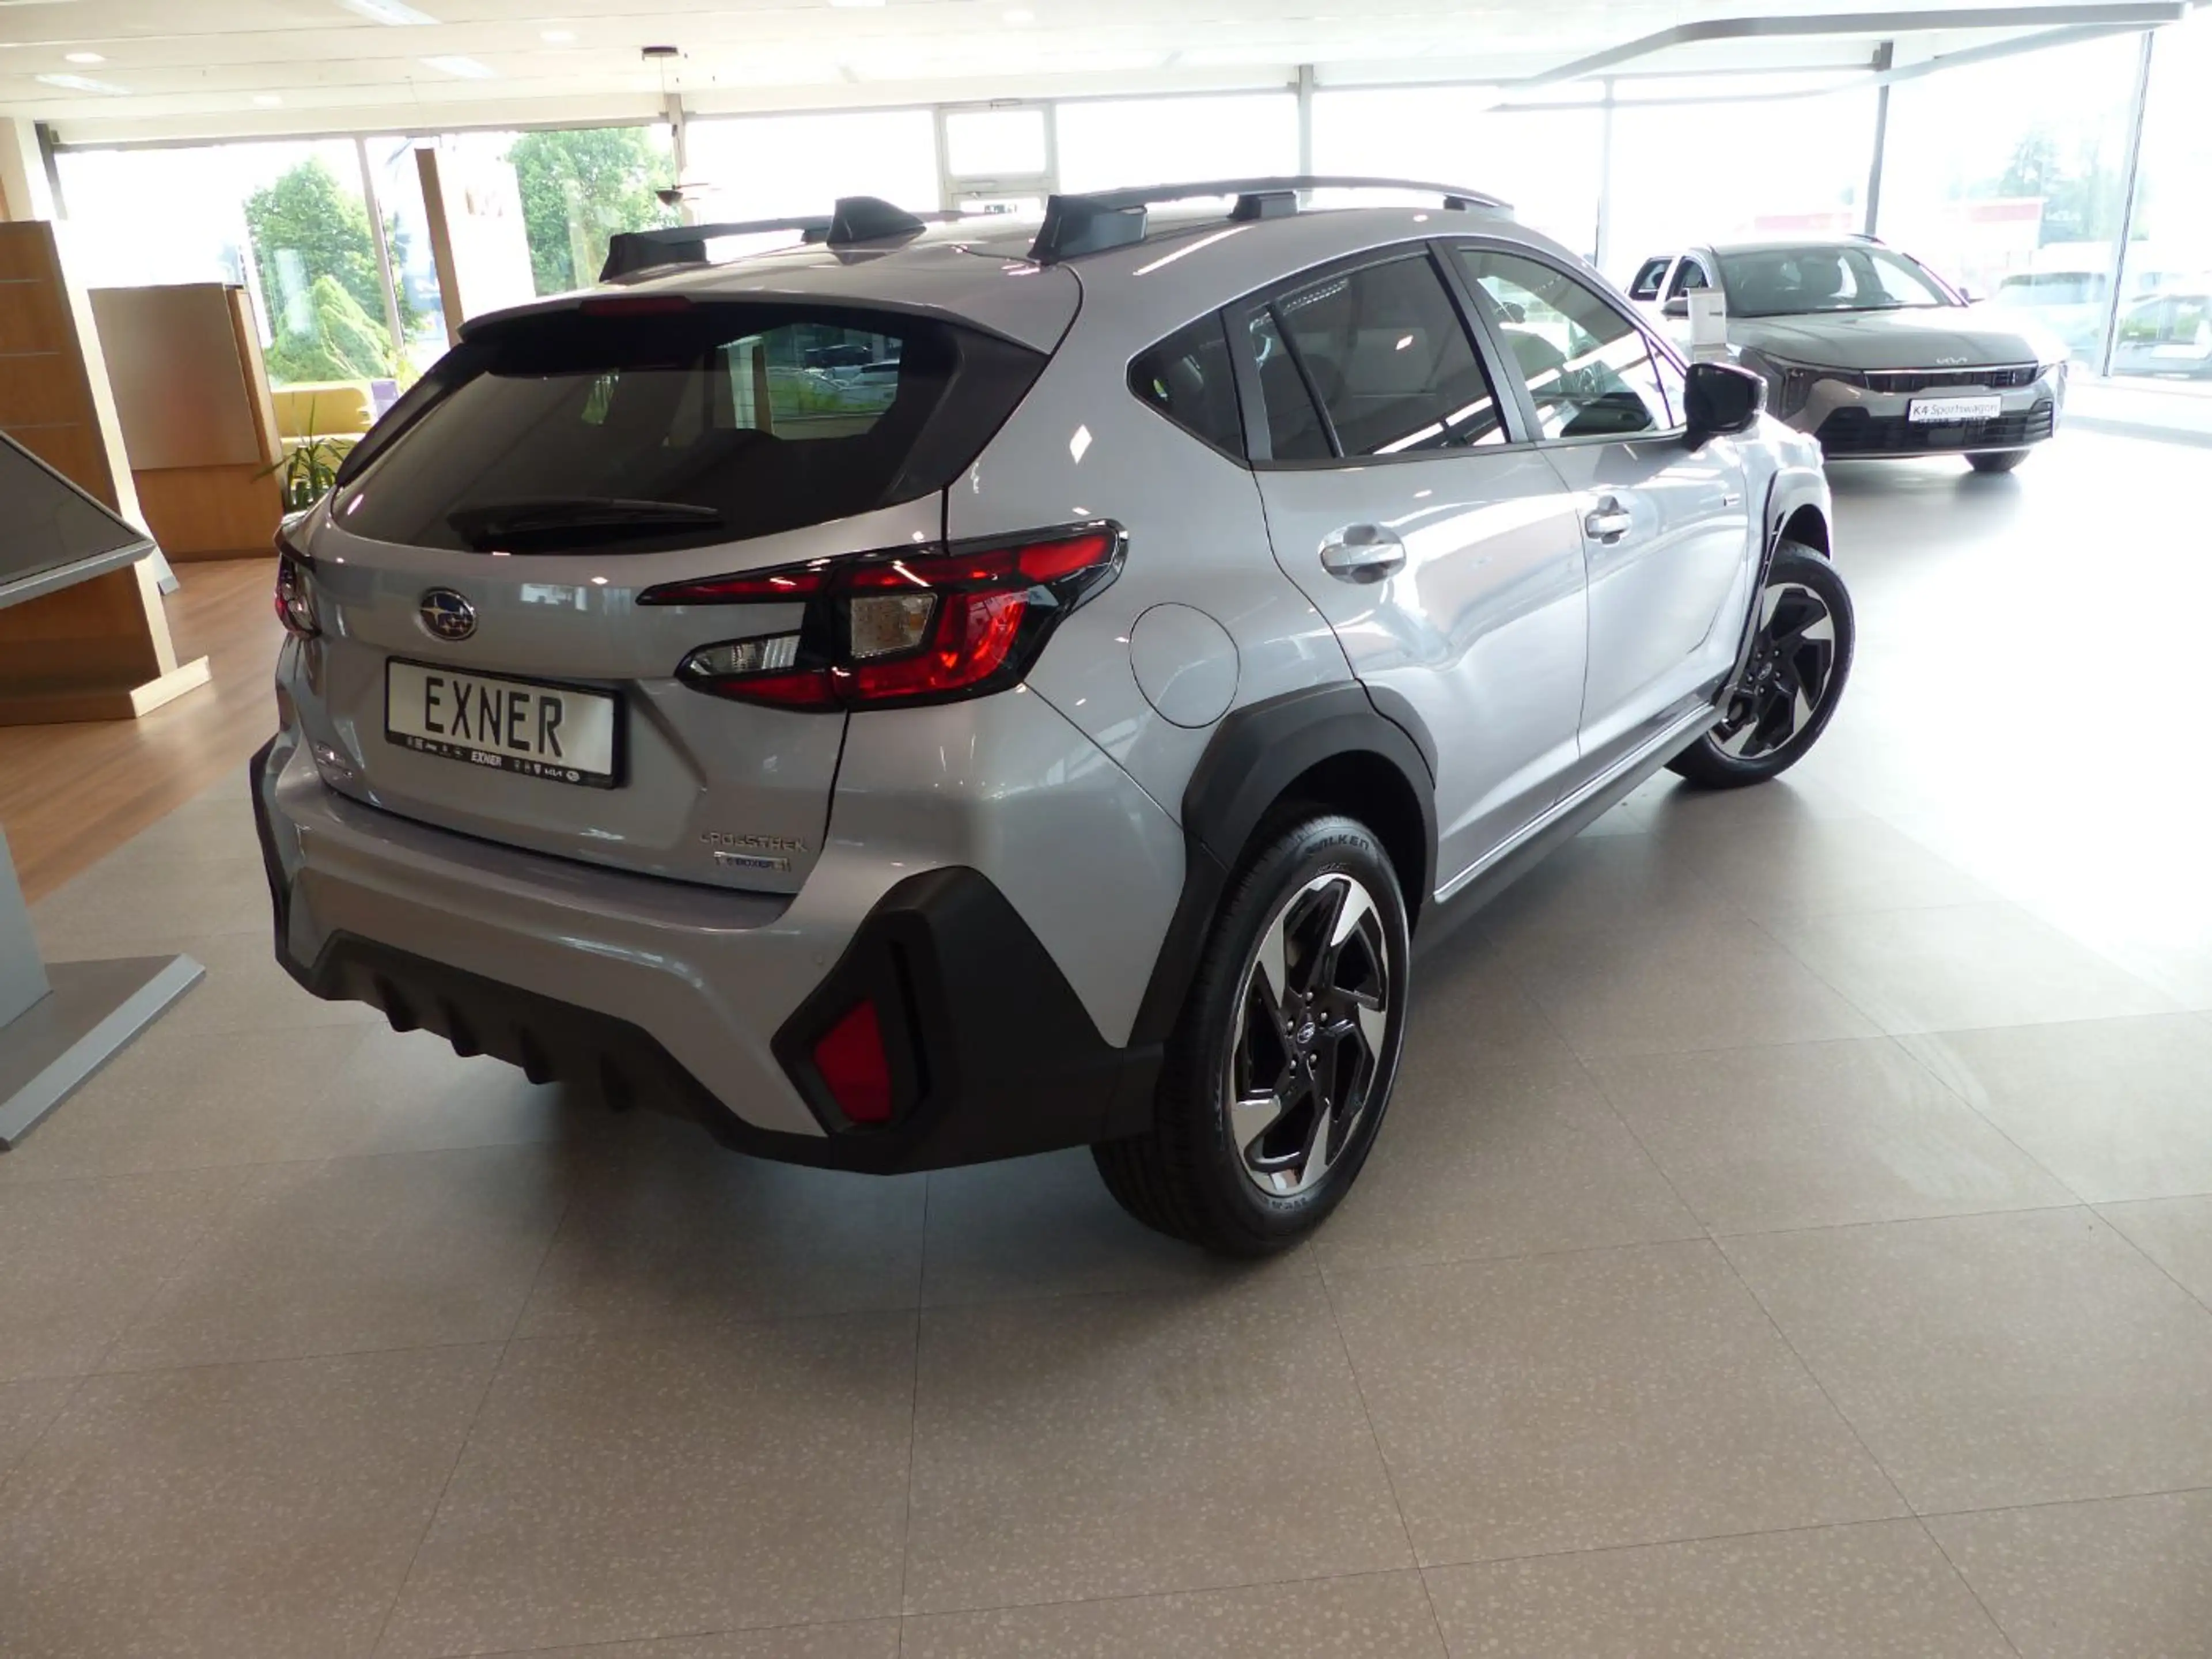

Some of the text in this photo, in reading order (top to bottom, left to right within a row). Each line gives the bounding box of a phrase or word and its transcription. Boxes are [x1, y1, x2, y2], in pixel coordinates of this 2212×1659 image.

[1913, 403, 1998, 416] K4 Sportswagon
[425, 676, 563, 757] EXNER
[471, 750, 502, 767] EXNER
[699, 832, 808, 852] CROSSTREK
